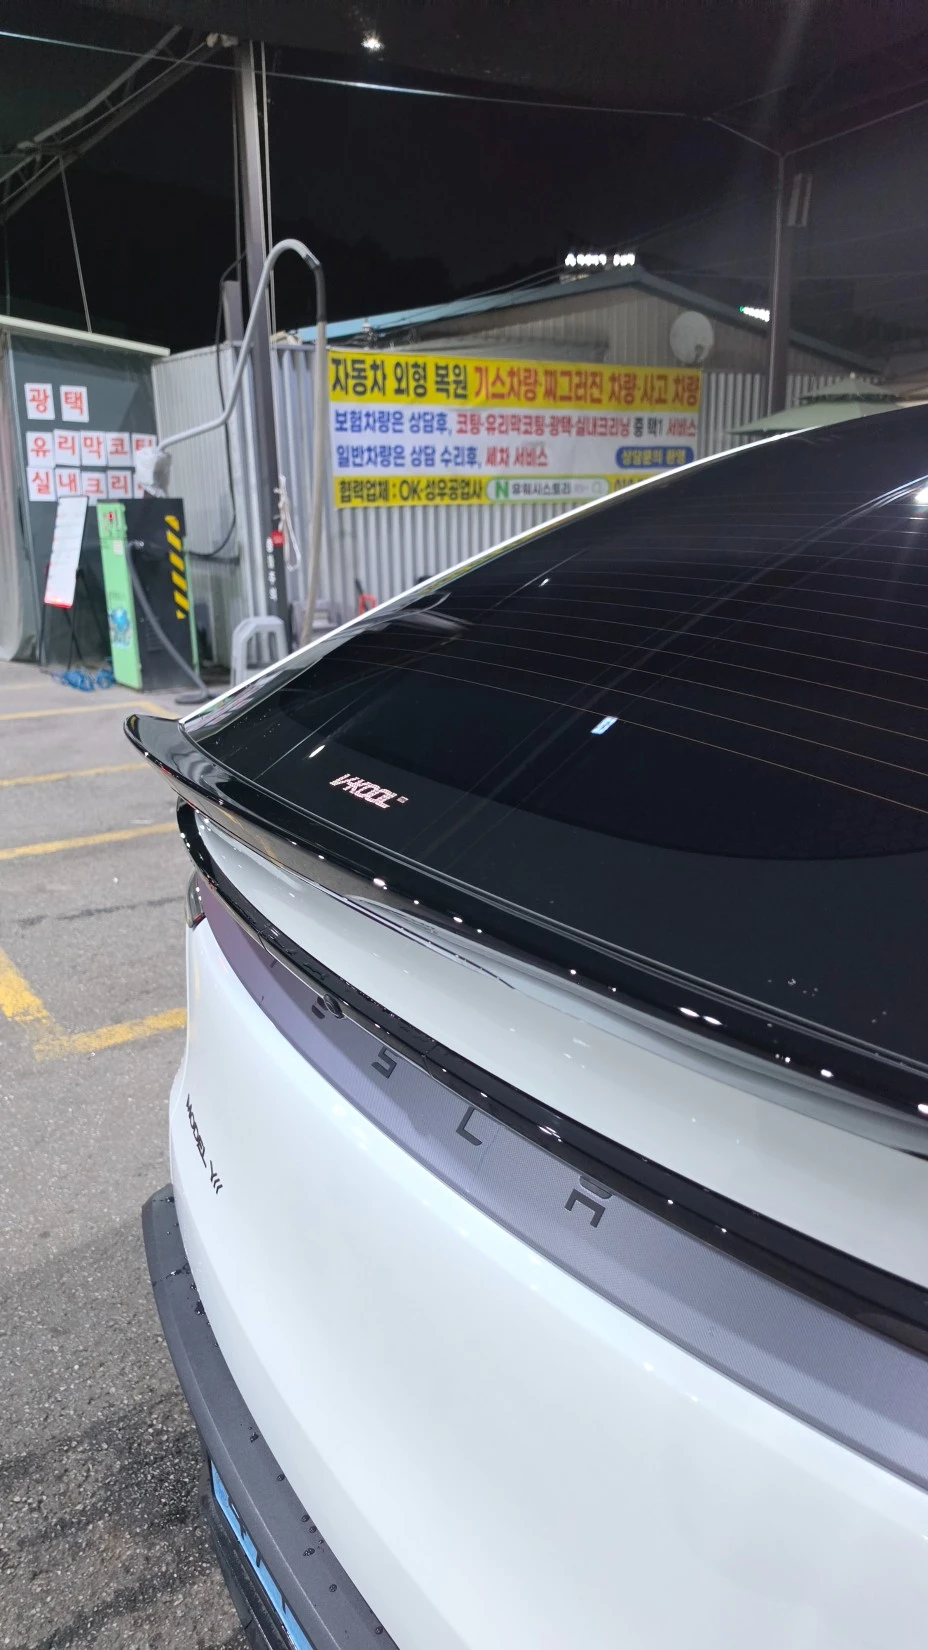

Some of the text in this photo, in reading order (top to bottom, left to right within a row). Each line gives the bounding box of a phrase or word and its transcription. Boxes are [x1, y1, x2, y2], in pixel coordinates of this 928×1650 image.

[331, 358, 387, 396] 자동차
[393, 361, 428, 398] 외형
[434, 362, 469, 400] 복원
[672, 374, 700, 407] 차량
[334, 410, 404, 434] 보험차량은
[409, 411, 453, 436] 상담후,
[666, 416, 697, 438] 서비스
[336, 444, 549, 470] 일반차량은 상담 수리후, 세차 서비스
[32, 471, 144, 495] 실내크리
